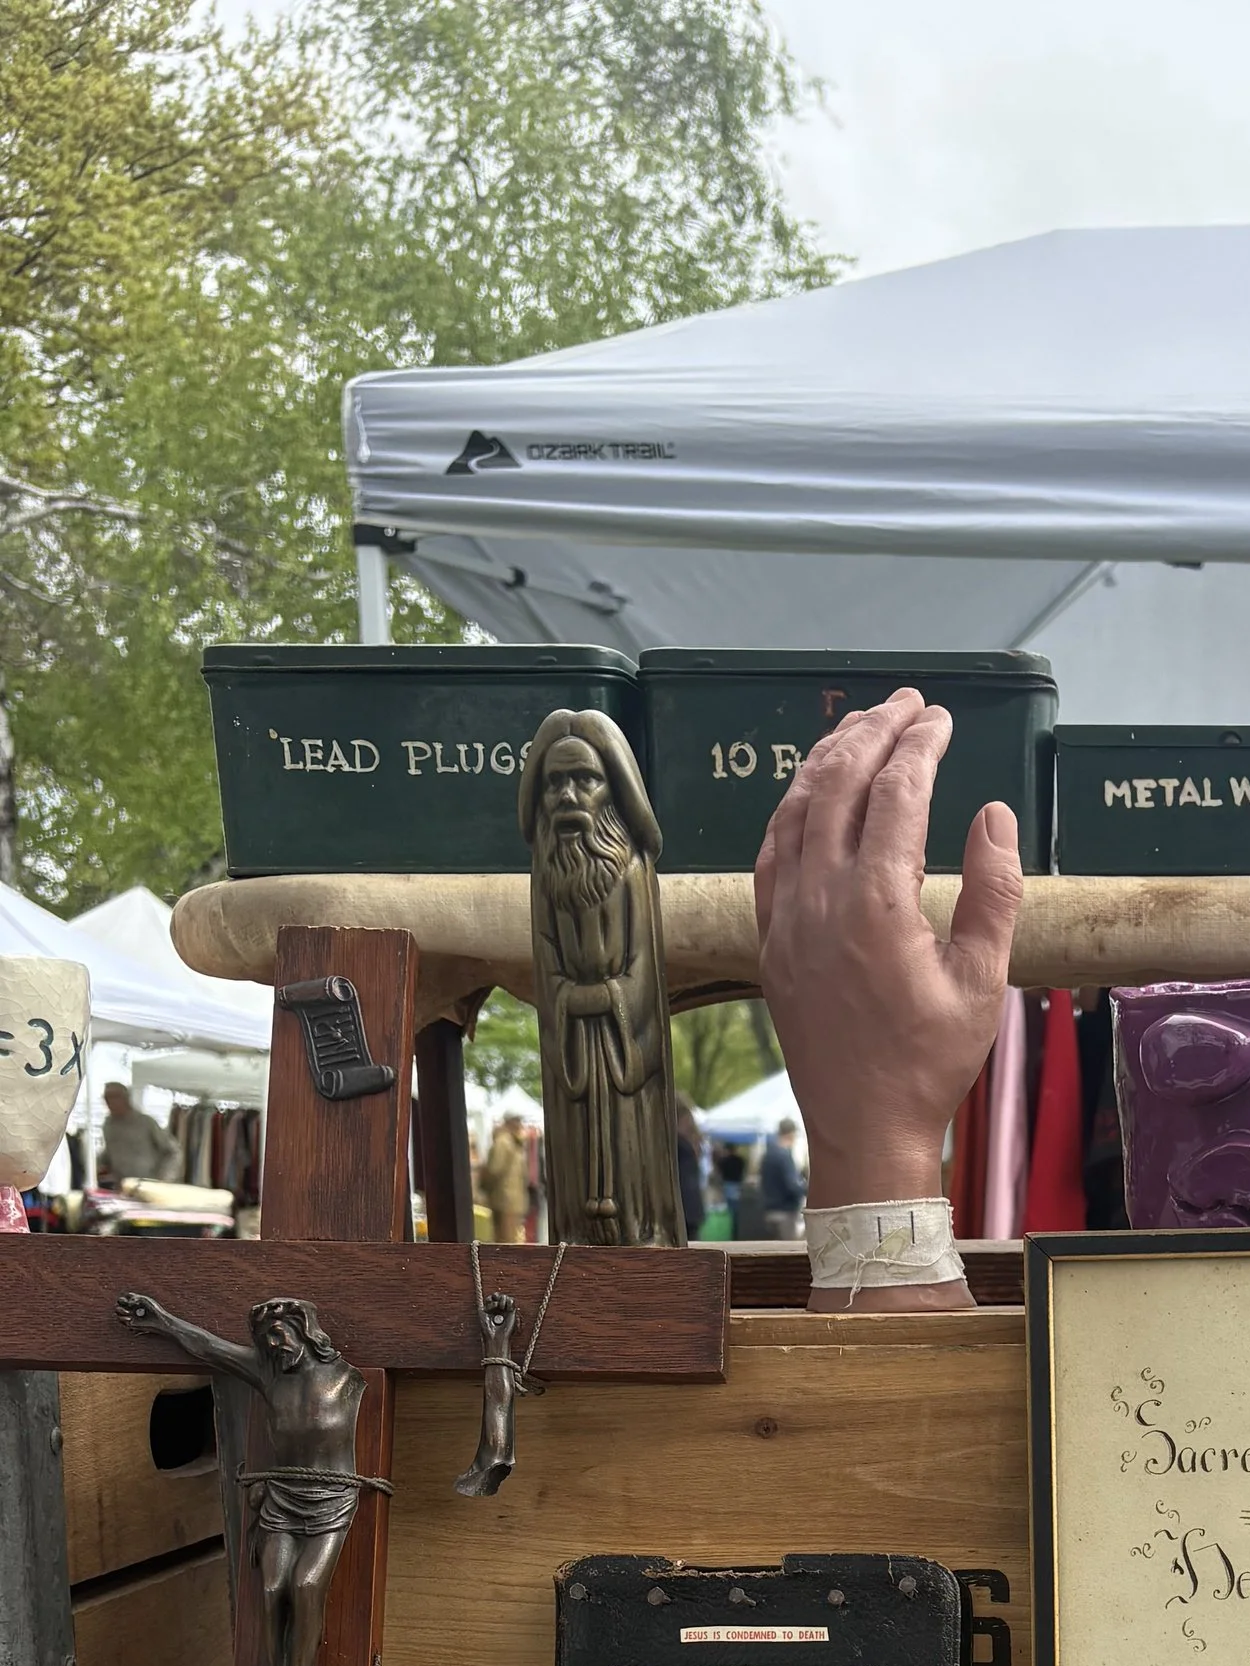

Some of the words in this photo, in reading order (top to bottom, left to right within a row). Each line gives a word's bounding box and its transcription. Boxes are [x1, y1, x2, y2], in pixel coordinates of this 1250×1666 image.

[279, 736, 380, 773] LEAD
[711, 741, 758, 779] 10
[1104, 774, 1223, 808] METAL
[684, 1630, 708, 1640] JESUS
[713, 1630, 721, 1640] IS
[726, 1630, 777, 1640] CONDEMNED
[782, 1630, 793, 1640] TO
[799, 1630, 825, 1640] DEATH
